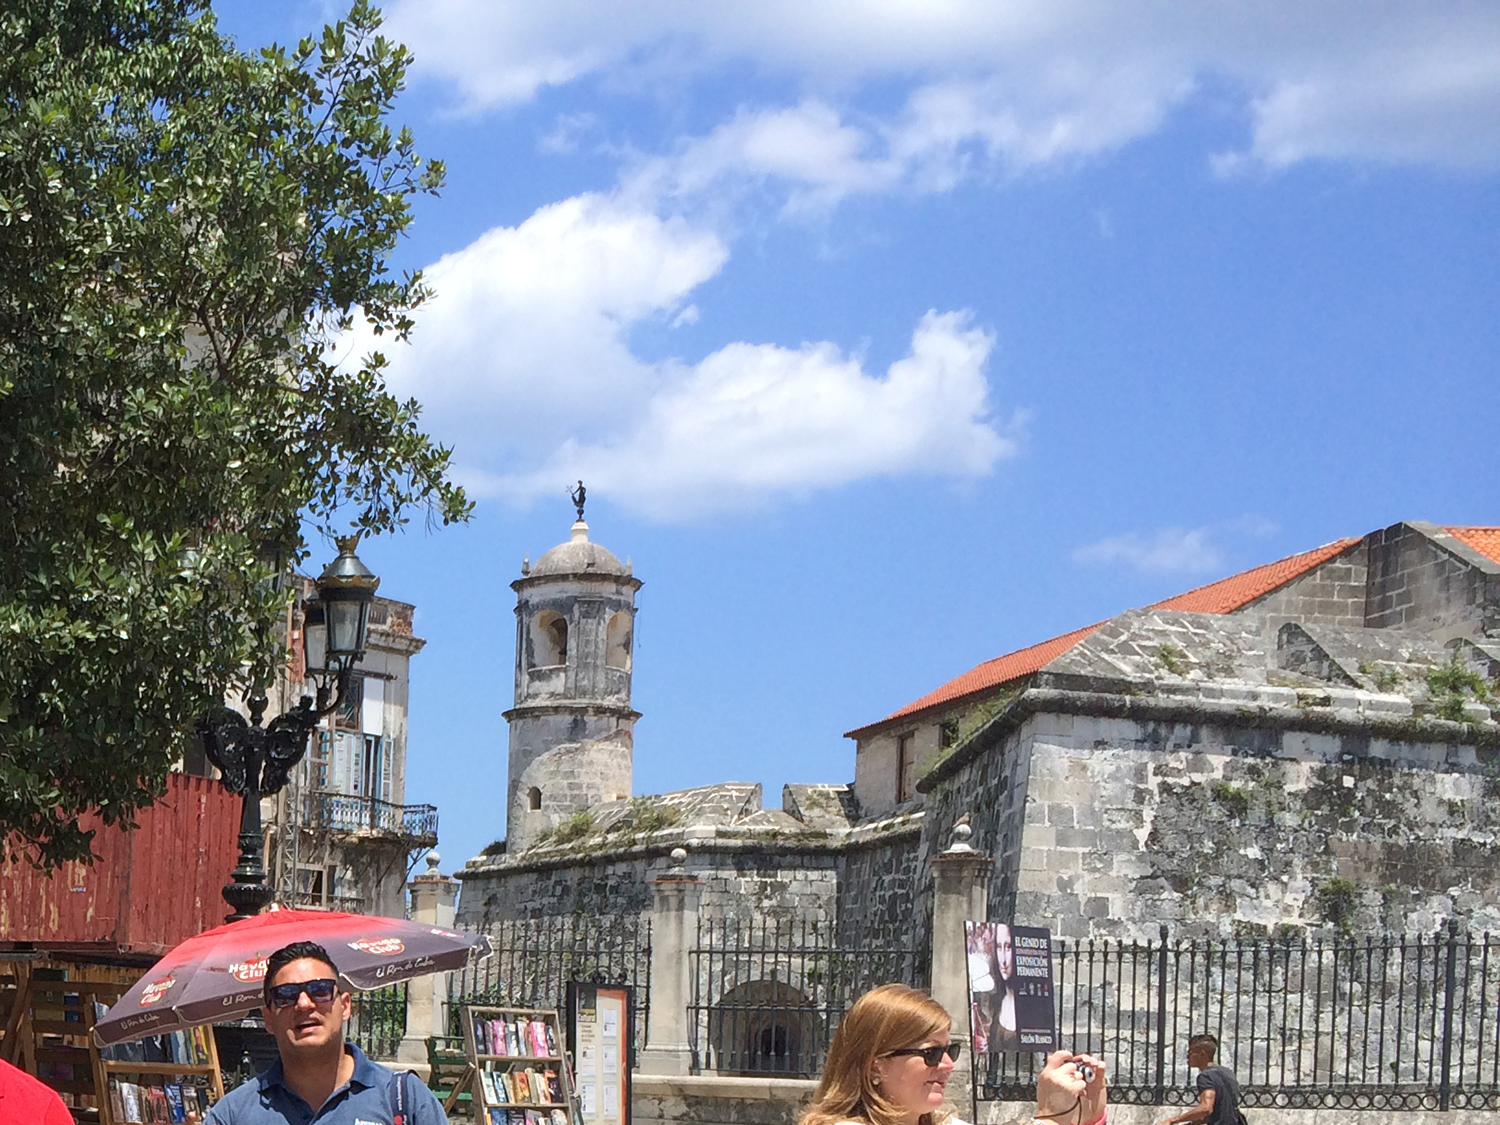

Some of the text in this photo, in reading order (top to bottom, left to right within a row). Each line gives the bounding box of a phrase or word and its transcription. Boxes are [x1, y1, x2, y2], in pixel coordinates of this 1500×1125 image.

[346, 938, 401, 950] Havana
[369, 944, 400, 954] Club
[1015, 936, 1048, 949] EL GENIO DE
[229, 959, 270, 973] Hava
[1016, 955, 1049, 968] EXPOSICIÓN
[376, 966, 385, 978] El
[387, 964, 404, 976] Ron
[141, 979, 176, 995] Havana
[222, 995, 233, 1006] El
[235, 994, 257, 1004] Ron
